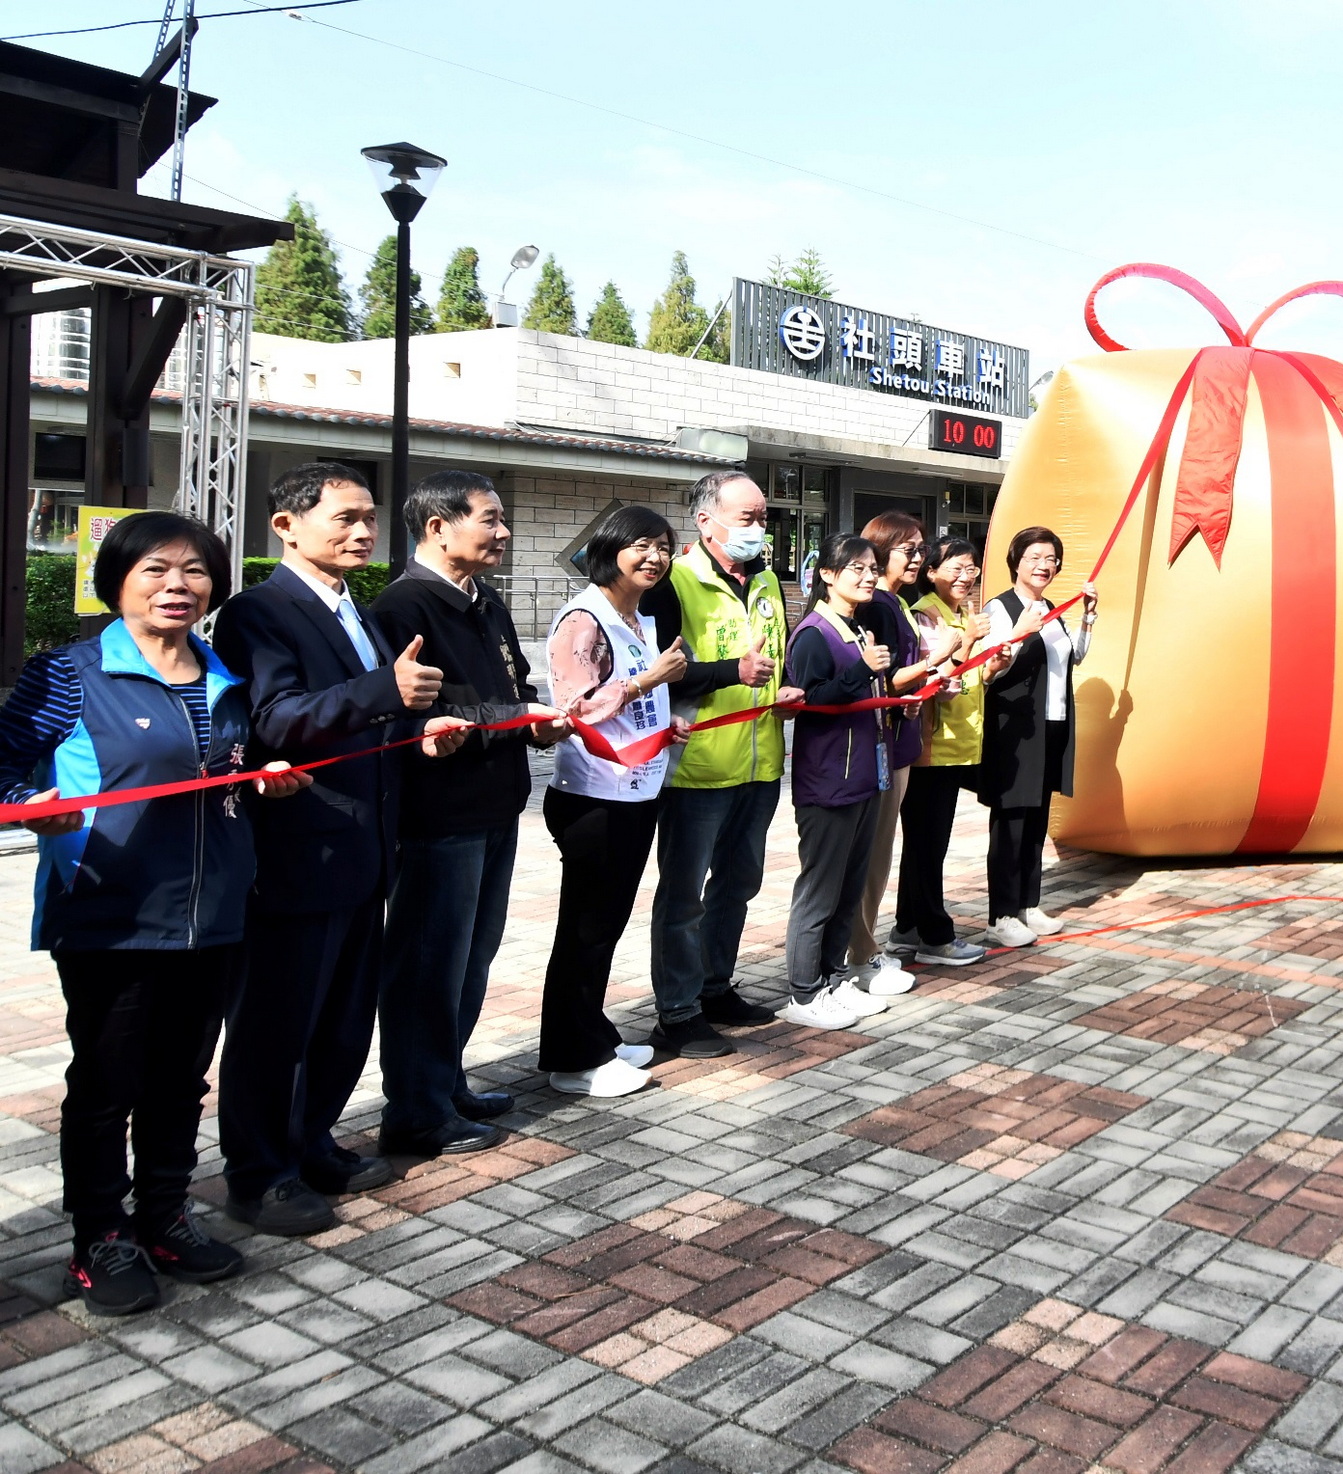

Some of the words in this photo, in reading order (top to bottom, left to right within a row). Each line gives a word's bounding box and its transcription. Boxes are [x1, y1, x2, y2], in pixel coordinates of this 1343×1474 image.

[841, 315, 1005, 389] 社頭車站
[870, 366, 930, 394] Shetou
[934, 379, 991, 405] Station
[943, 419, 965, 443] 10
[973, 425, 995, 448] 00
